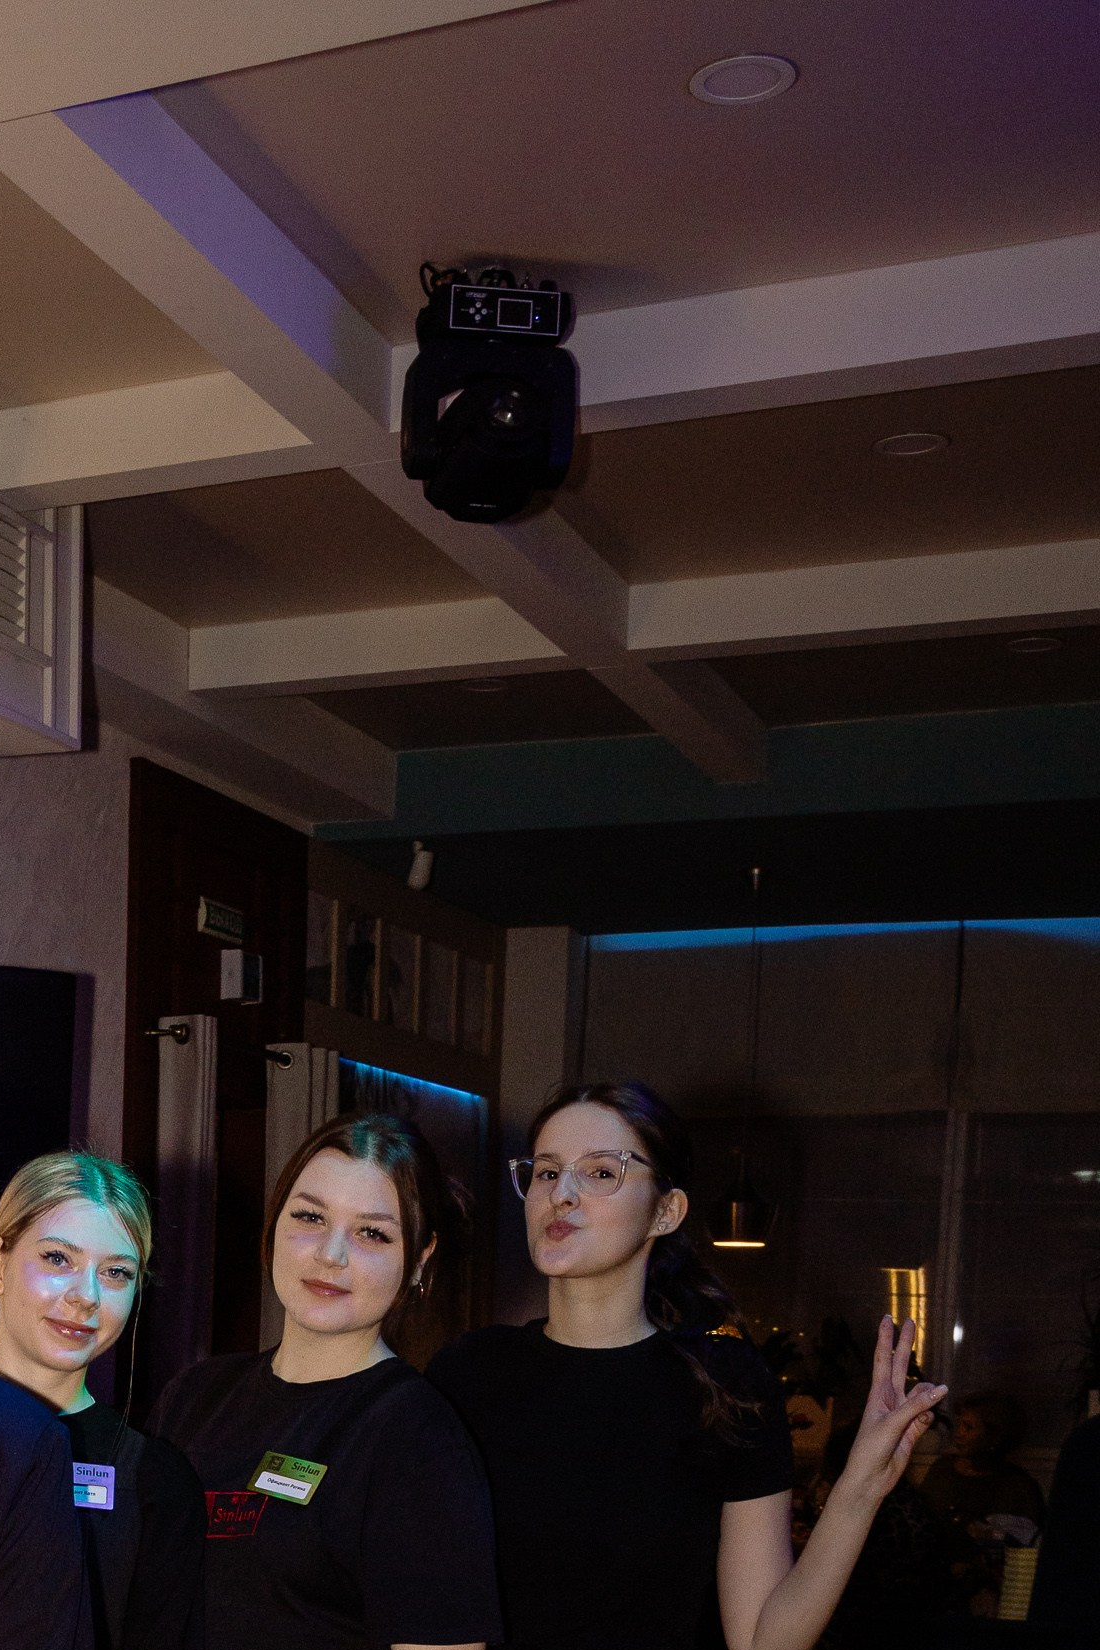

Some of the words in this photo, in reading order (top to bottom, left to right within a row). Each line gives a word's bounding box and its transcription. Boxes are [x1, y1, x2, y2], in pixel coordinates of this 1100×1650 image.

[76, 1466, 109, 1478] Sinlun
[291, 1461, 320, 1476] Sinlun
[213, 1506, 256, 1523] Sinlun
